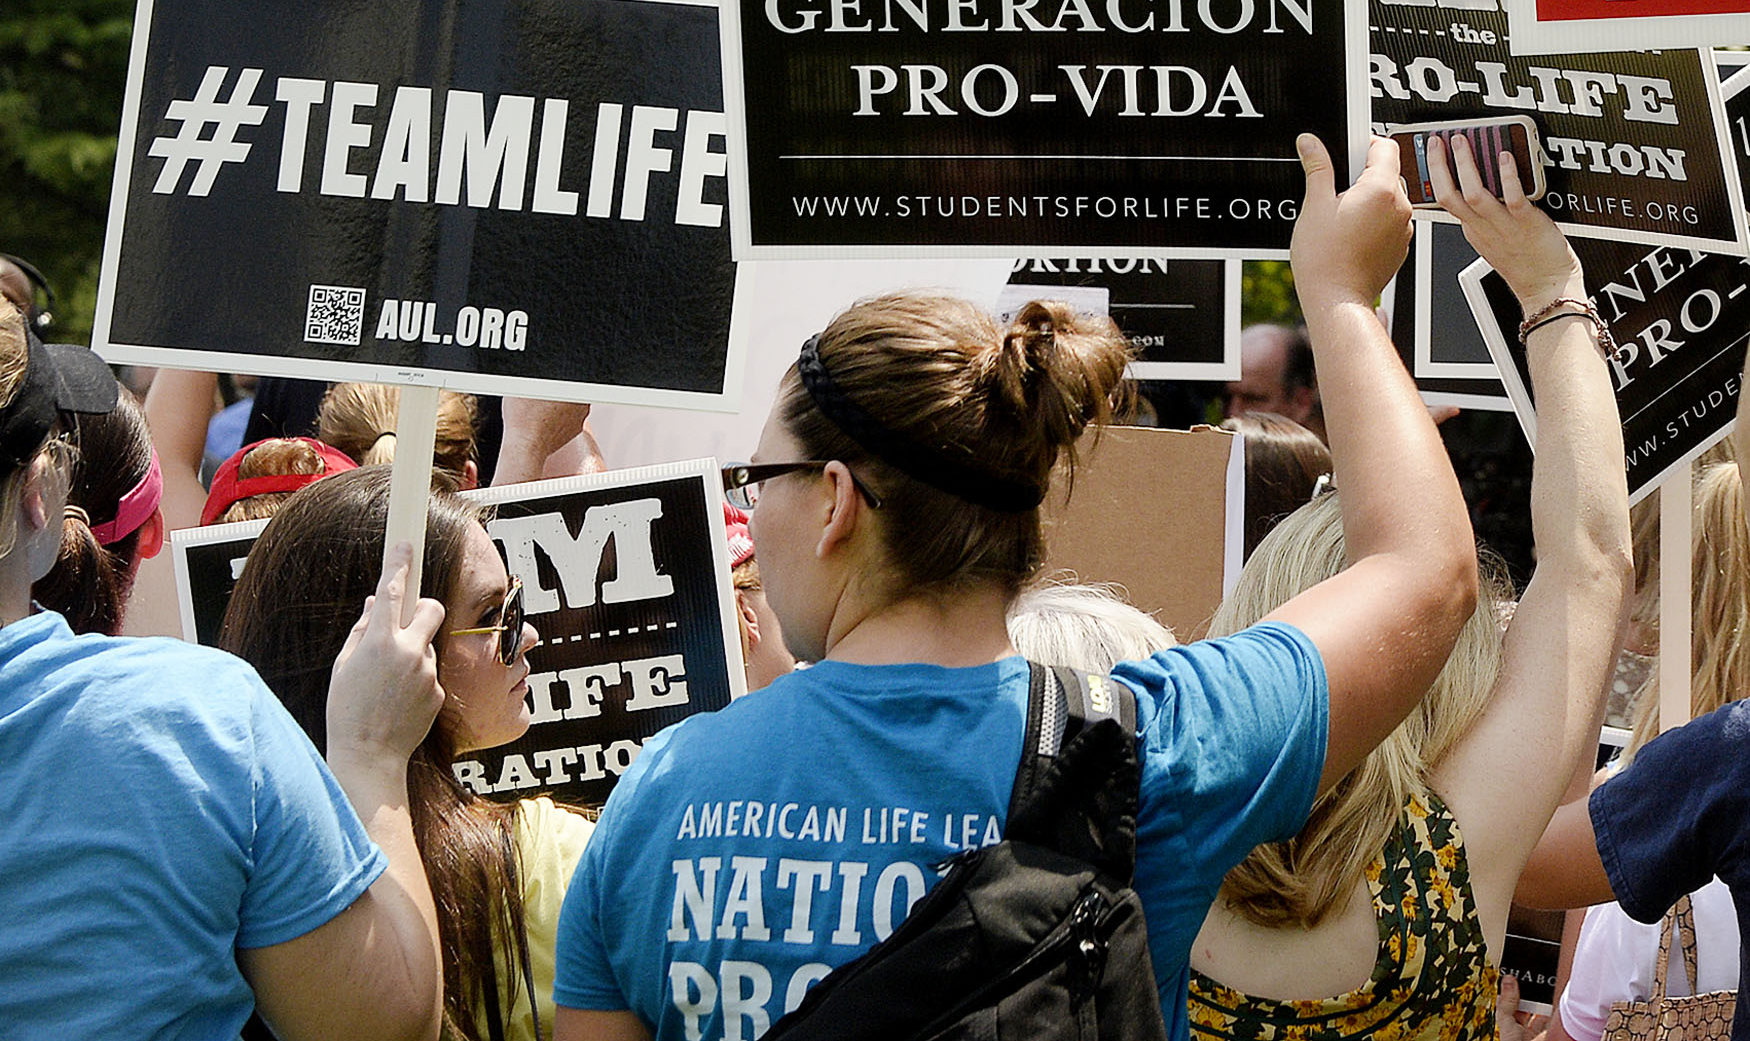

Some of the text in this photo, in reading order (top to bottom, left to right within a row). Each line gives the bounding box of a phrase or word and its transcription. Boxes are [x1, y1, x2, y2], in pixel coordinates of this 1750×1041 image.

[1450, 23, 1496, 45] the
[851, 63, 1264, 117] PRO-VIDA
[1370, 53, 1679, 126] RO-LIFE
[147, 65, 729, 228] #TEAMLIFE
[1541, 136, 1688, 181] TION
[792, 194, 1297, 220] WWW.STUDENTSFORLIFE.ORG
[376, 299, 529, 351] AUL.ORG
[486, 497, 674, 616] M
[526, 654, 689, 725] IFE
[451, 736, 651, 795] RATIO
[677, 801, 848, 843] AMERICAN
[862, 807, 929, 844] LIFE
[667, 856, 934, 946] NATIO
